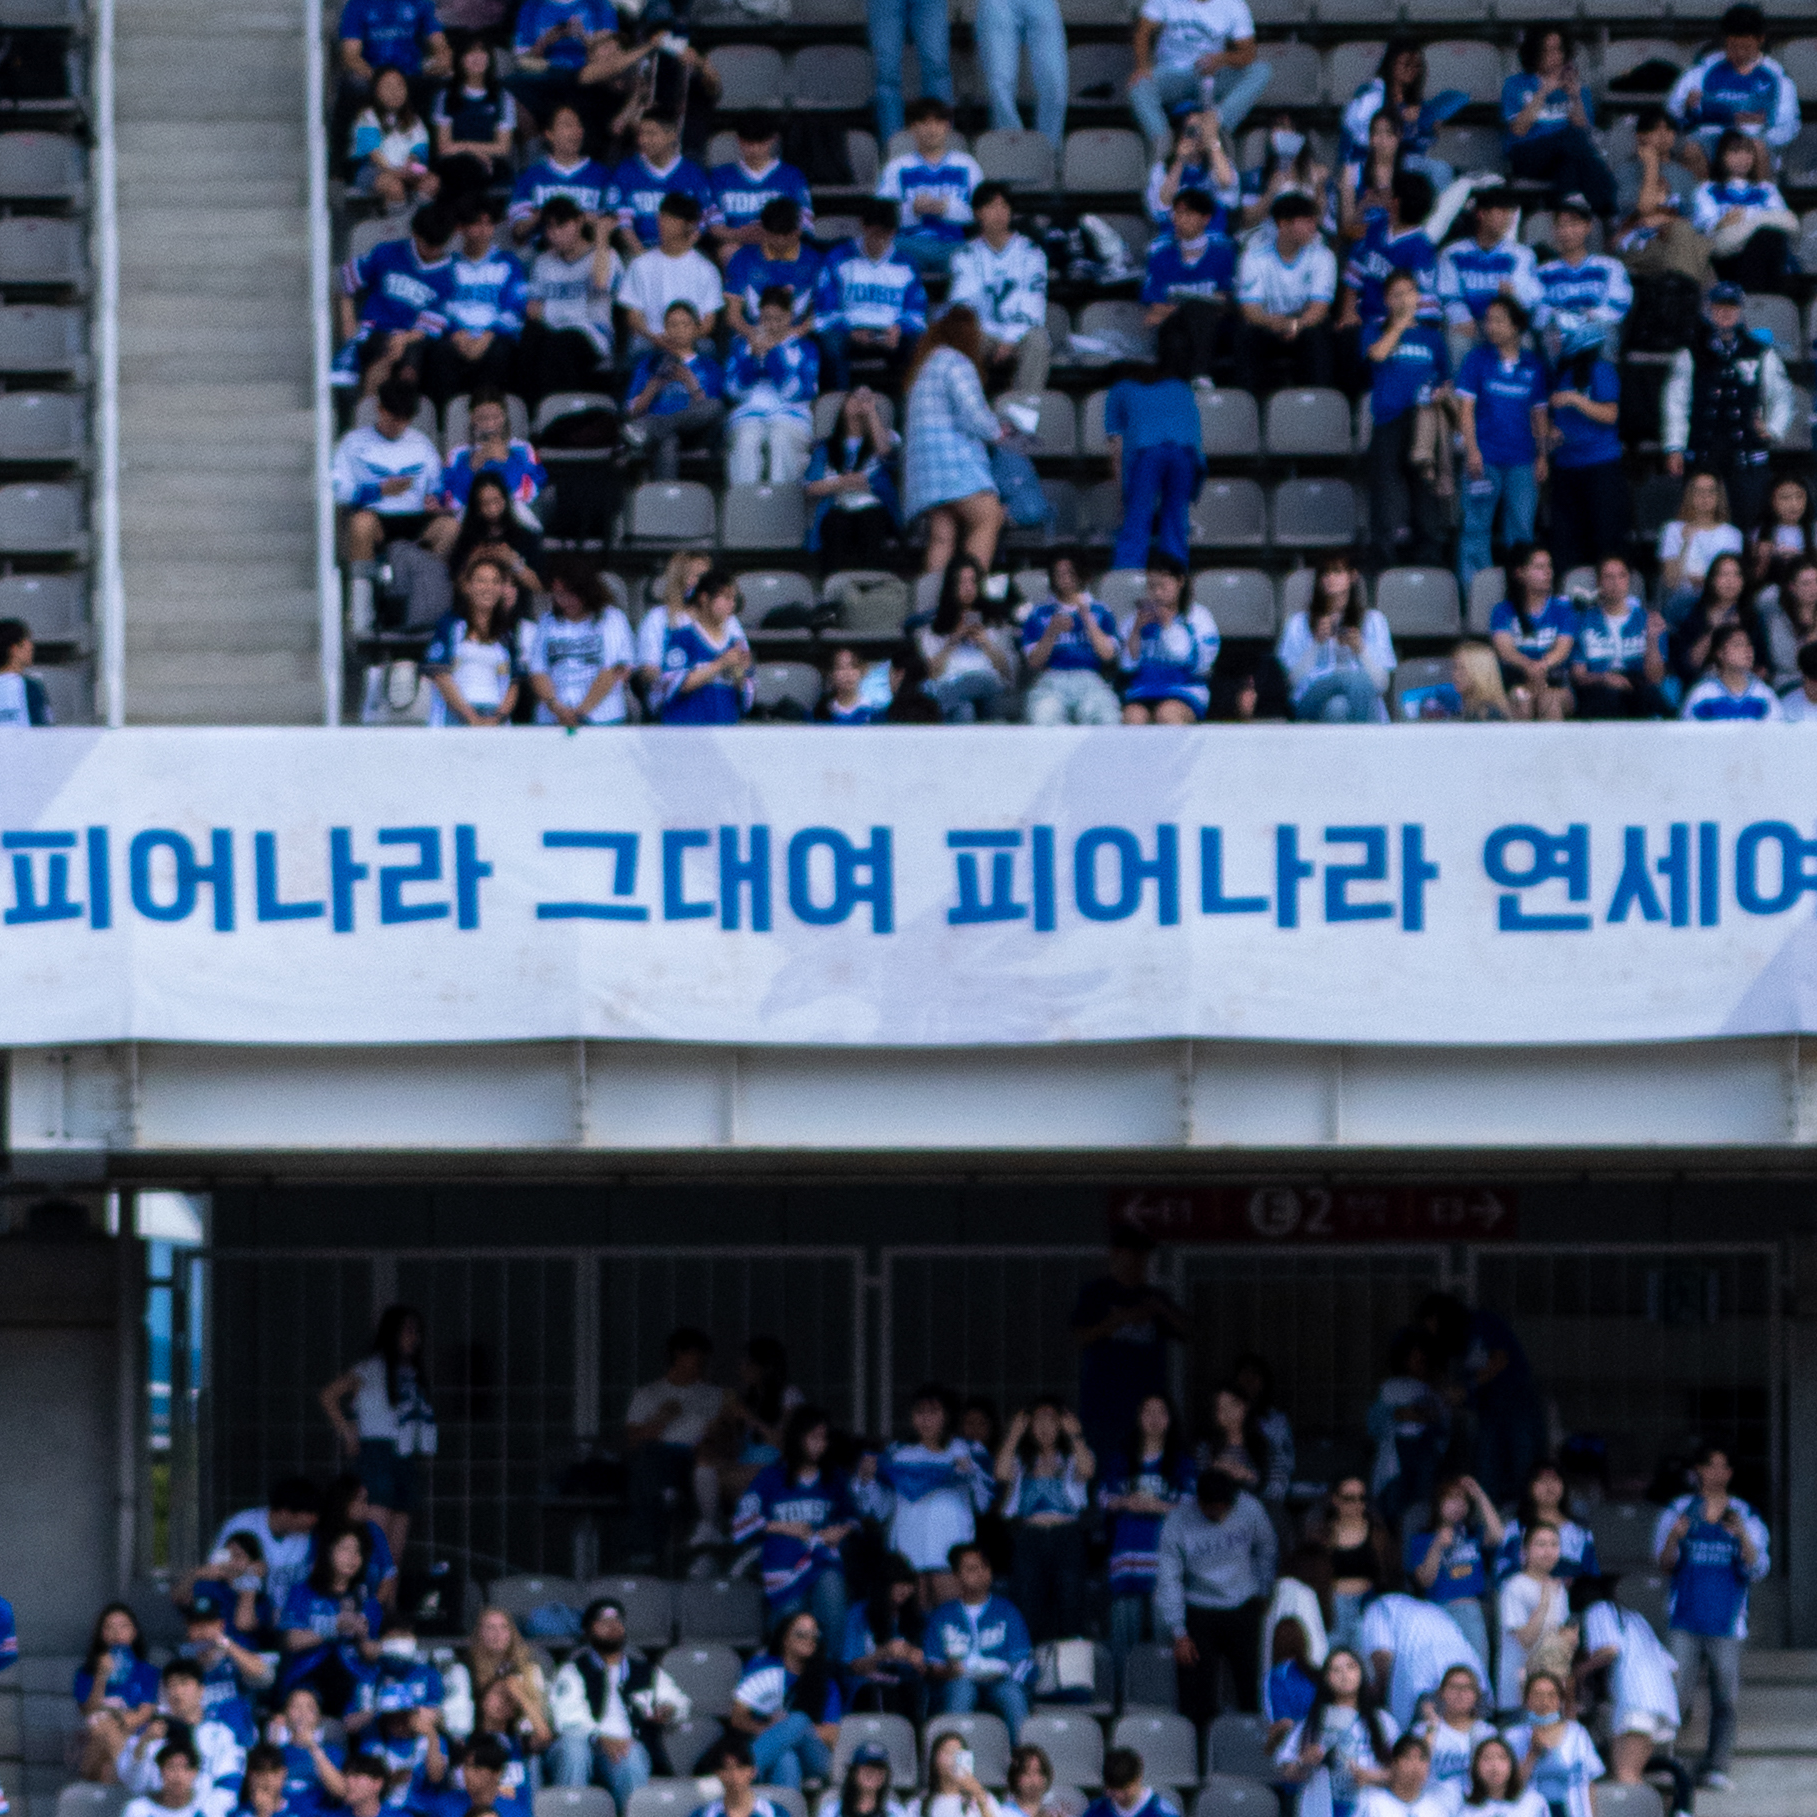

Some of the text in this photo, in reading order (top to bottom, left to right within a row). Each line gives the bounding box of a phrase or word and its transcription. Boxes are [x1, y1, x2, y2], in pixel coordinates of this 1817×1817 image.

[1, 824, 492, 933] 피어나라
[536, 824, 894, 934] 그대여
[945, 822, 1439, 932] 피어나라
